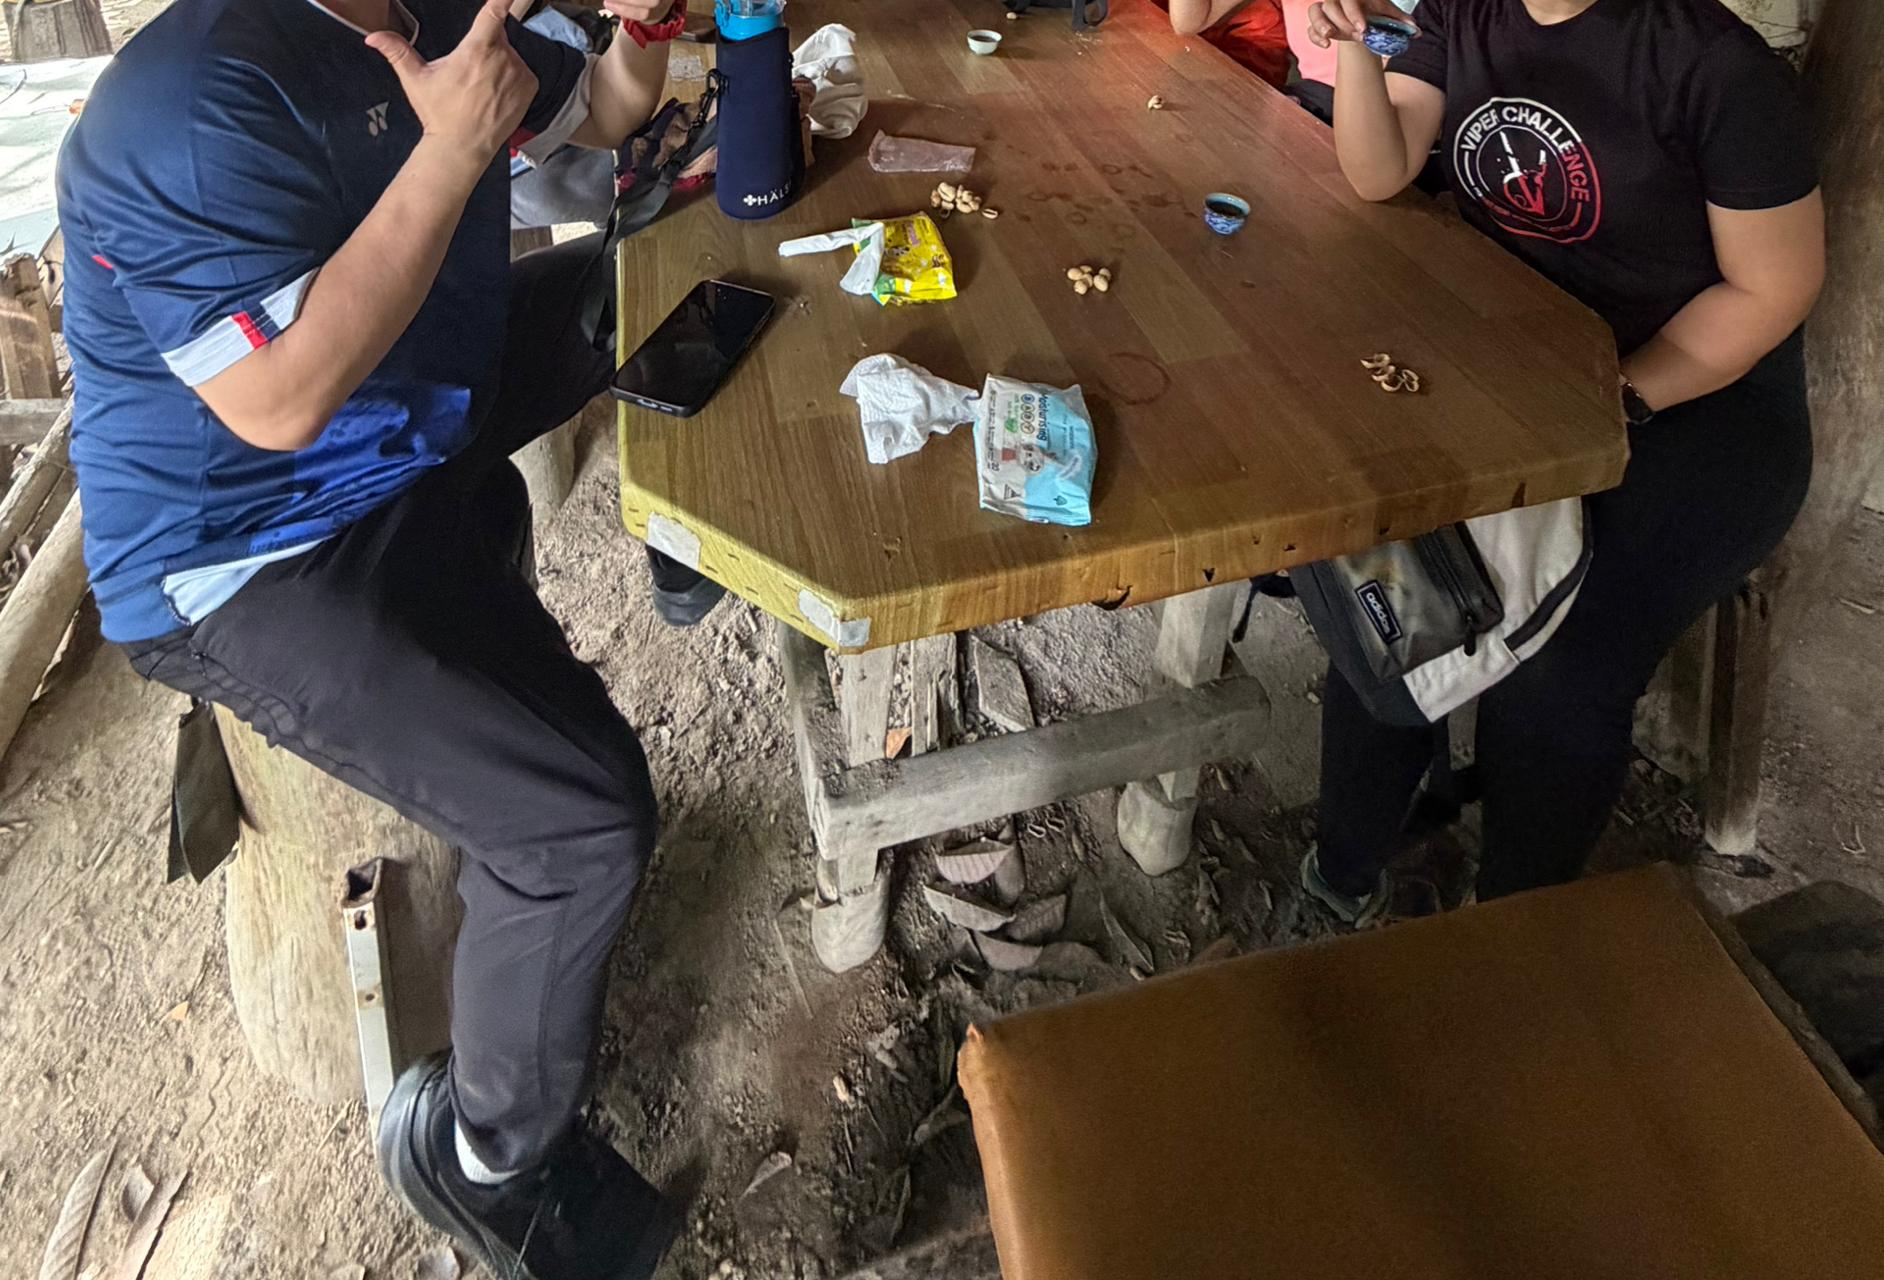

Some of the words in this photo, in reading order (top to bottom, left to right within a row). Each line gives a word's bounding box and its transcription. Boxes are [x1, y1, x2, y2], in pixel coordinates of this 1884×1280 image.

[1461, 109, 1500, 151] VIPER
[1502, 106, 1590, 202] CHALLENGE
[757, 179, 792, 206] HÄLS
[1366, 592, 1390, 634] adidas
